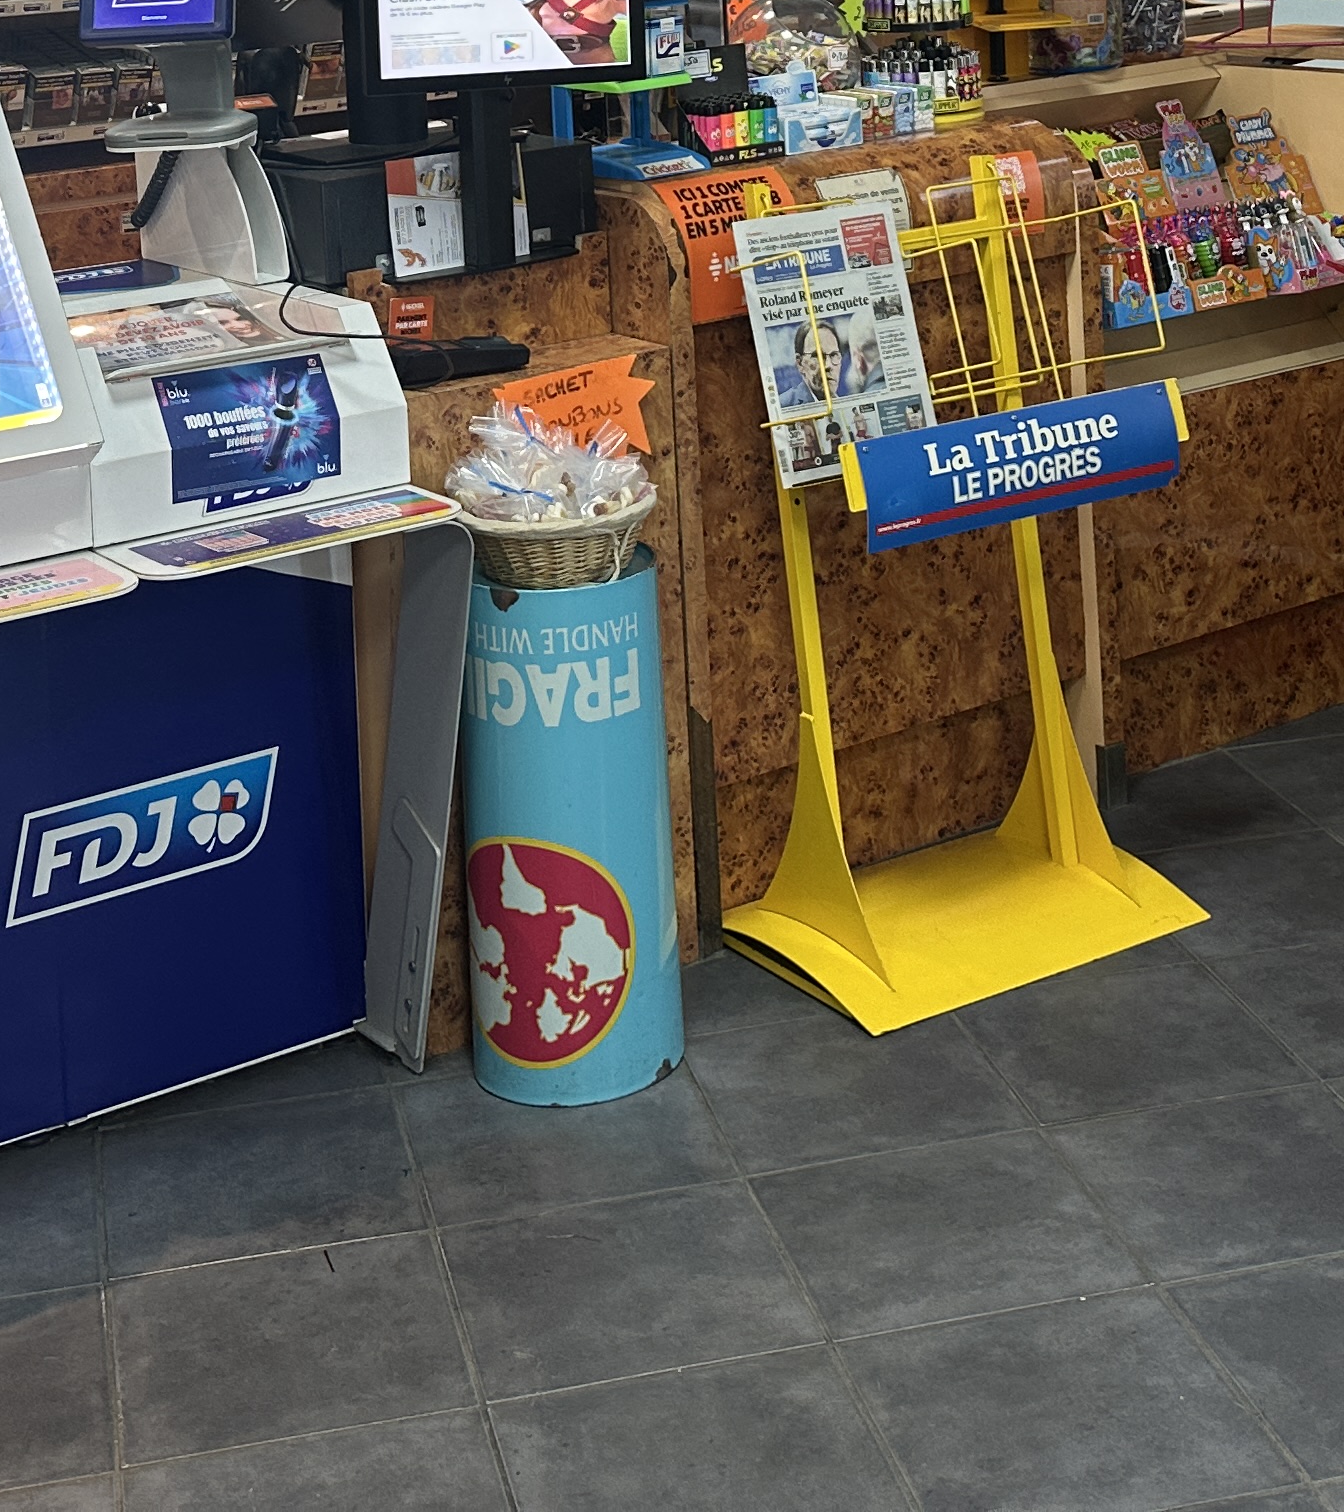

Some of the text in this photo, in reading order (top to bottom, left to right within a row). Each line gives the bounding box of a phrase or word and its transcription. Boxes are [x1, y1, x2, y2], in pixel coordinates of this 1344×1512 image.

[693, 196, 745, 217] CARTE
[685, 219, 720, 239] EN 5
[759, 291, 799, 309] Roland
[762, 294, 871, 323] visé par enquête
[165, 384, 191, 400] blu
[522, 369, 594, 407] SACHET
[183, 409, 213, 430] 1000
[923, 413, 1119, 477] La Tribune
[316, 457, 339, 475] blu
[953, 446, 1103, 504] LE PROGRÈS
[474, 611, 639, 655] HANDLE WITH
[32, 795, 178, 899] FDJ
